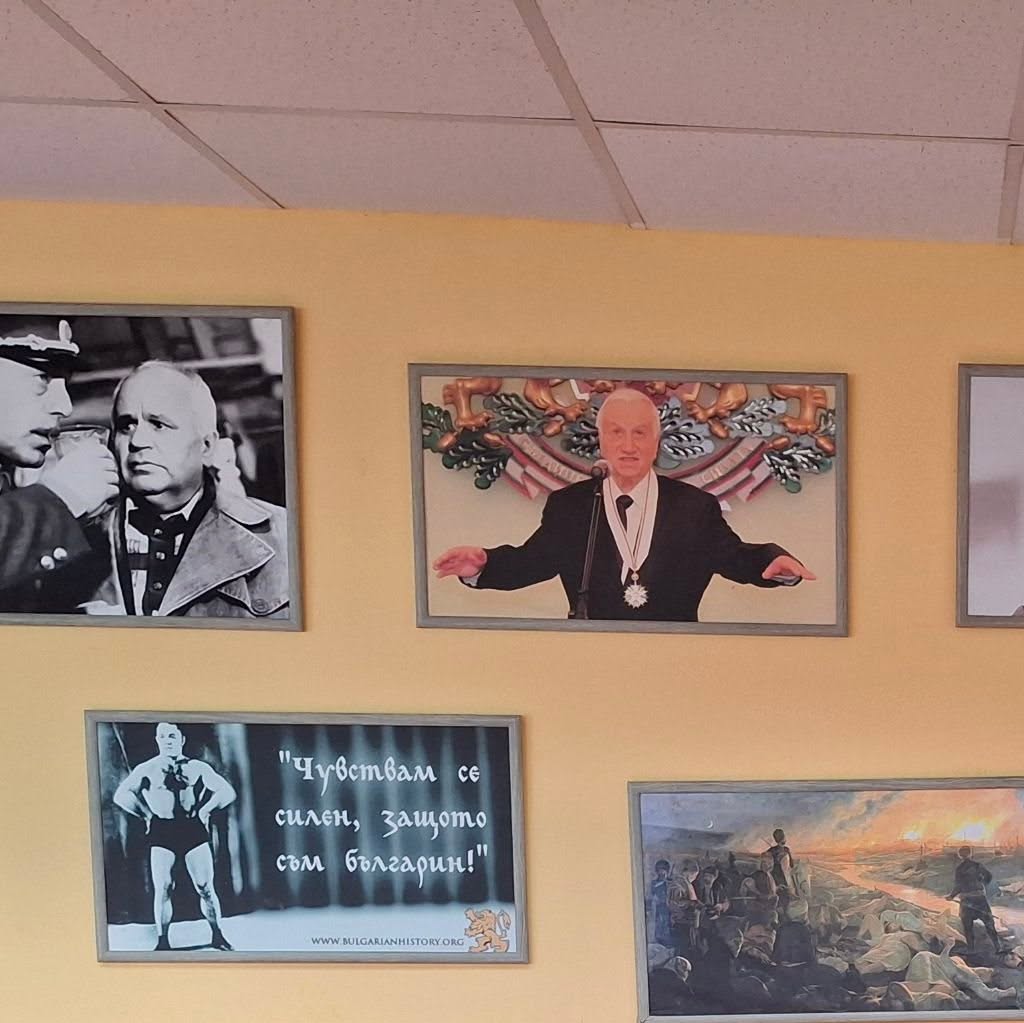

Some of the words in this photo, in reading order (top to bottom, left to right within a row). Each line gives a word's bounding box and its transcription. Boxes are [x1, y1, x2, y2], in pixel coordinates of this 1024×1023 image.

[278, 750, 438, 797] "Чувствам
[458, 765, 480, 783] се
[275, 808, 361, 832] силен,
[381, 809, 487, 840] защото
[276, 853, 325, 872] съм
[345, 843, 488, 889] българин!"
[311, 937, 465, 946] WWW.BULGARIANHISTORY.ORG
